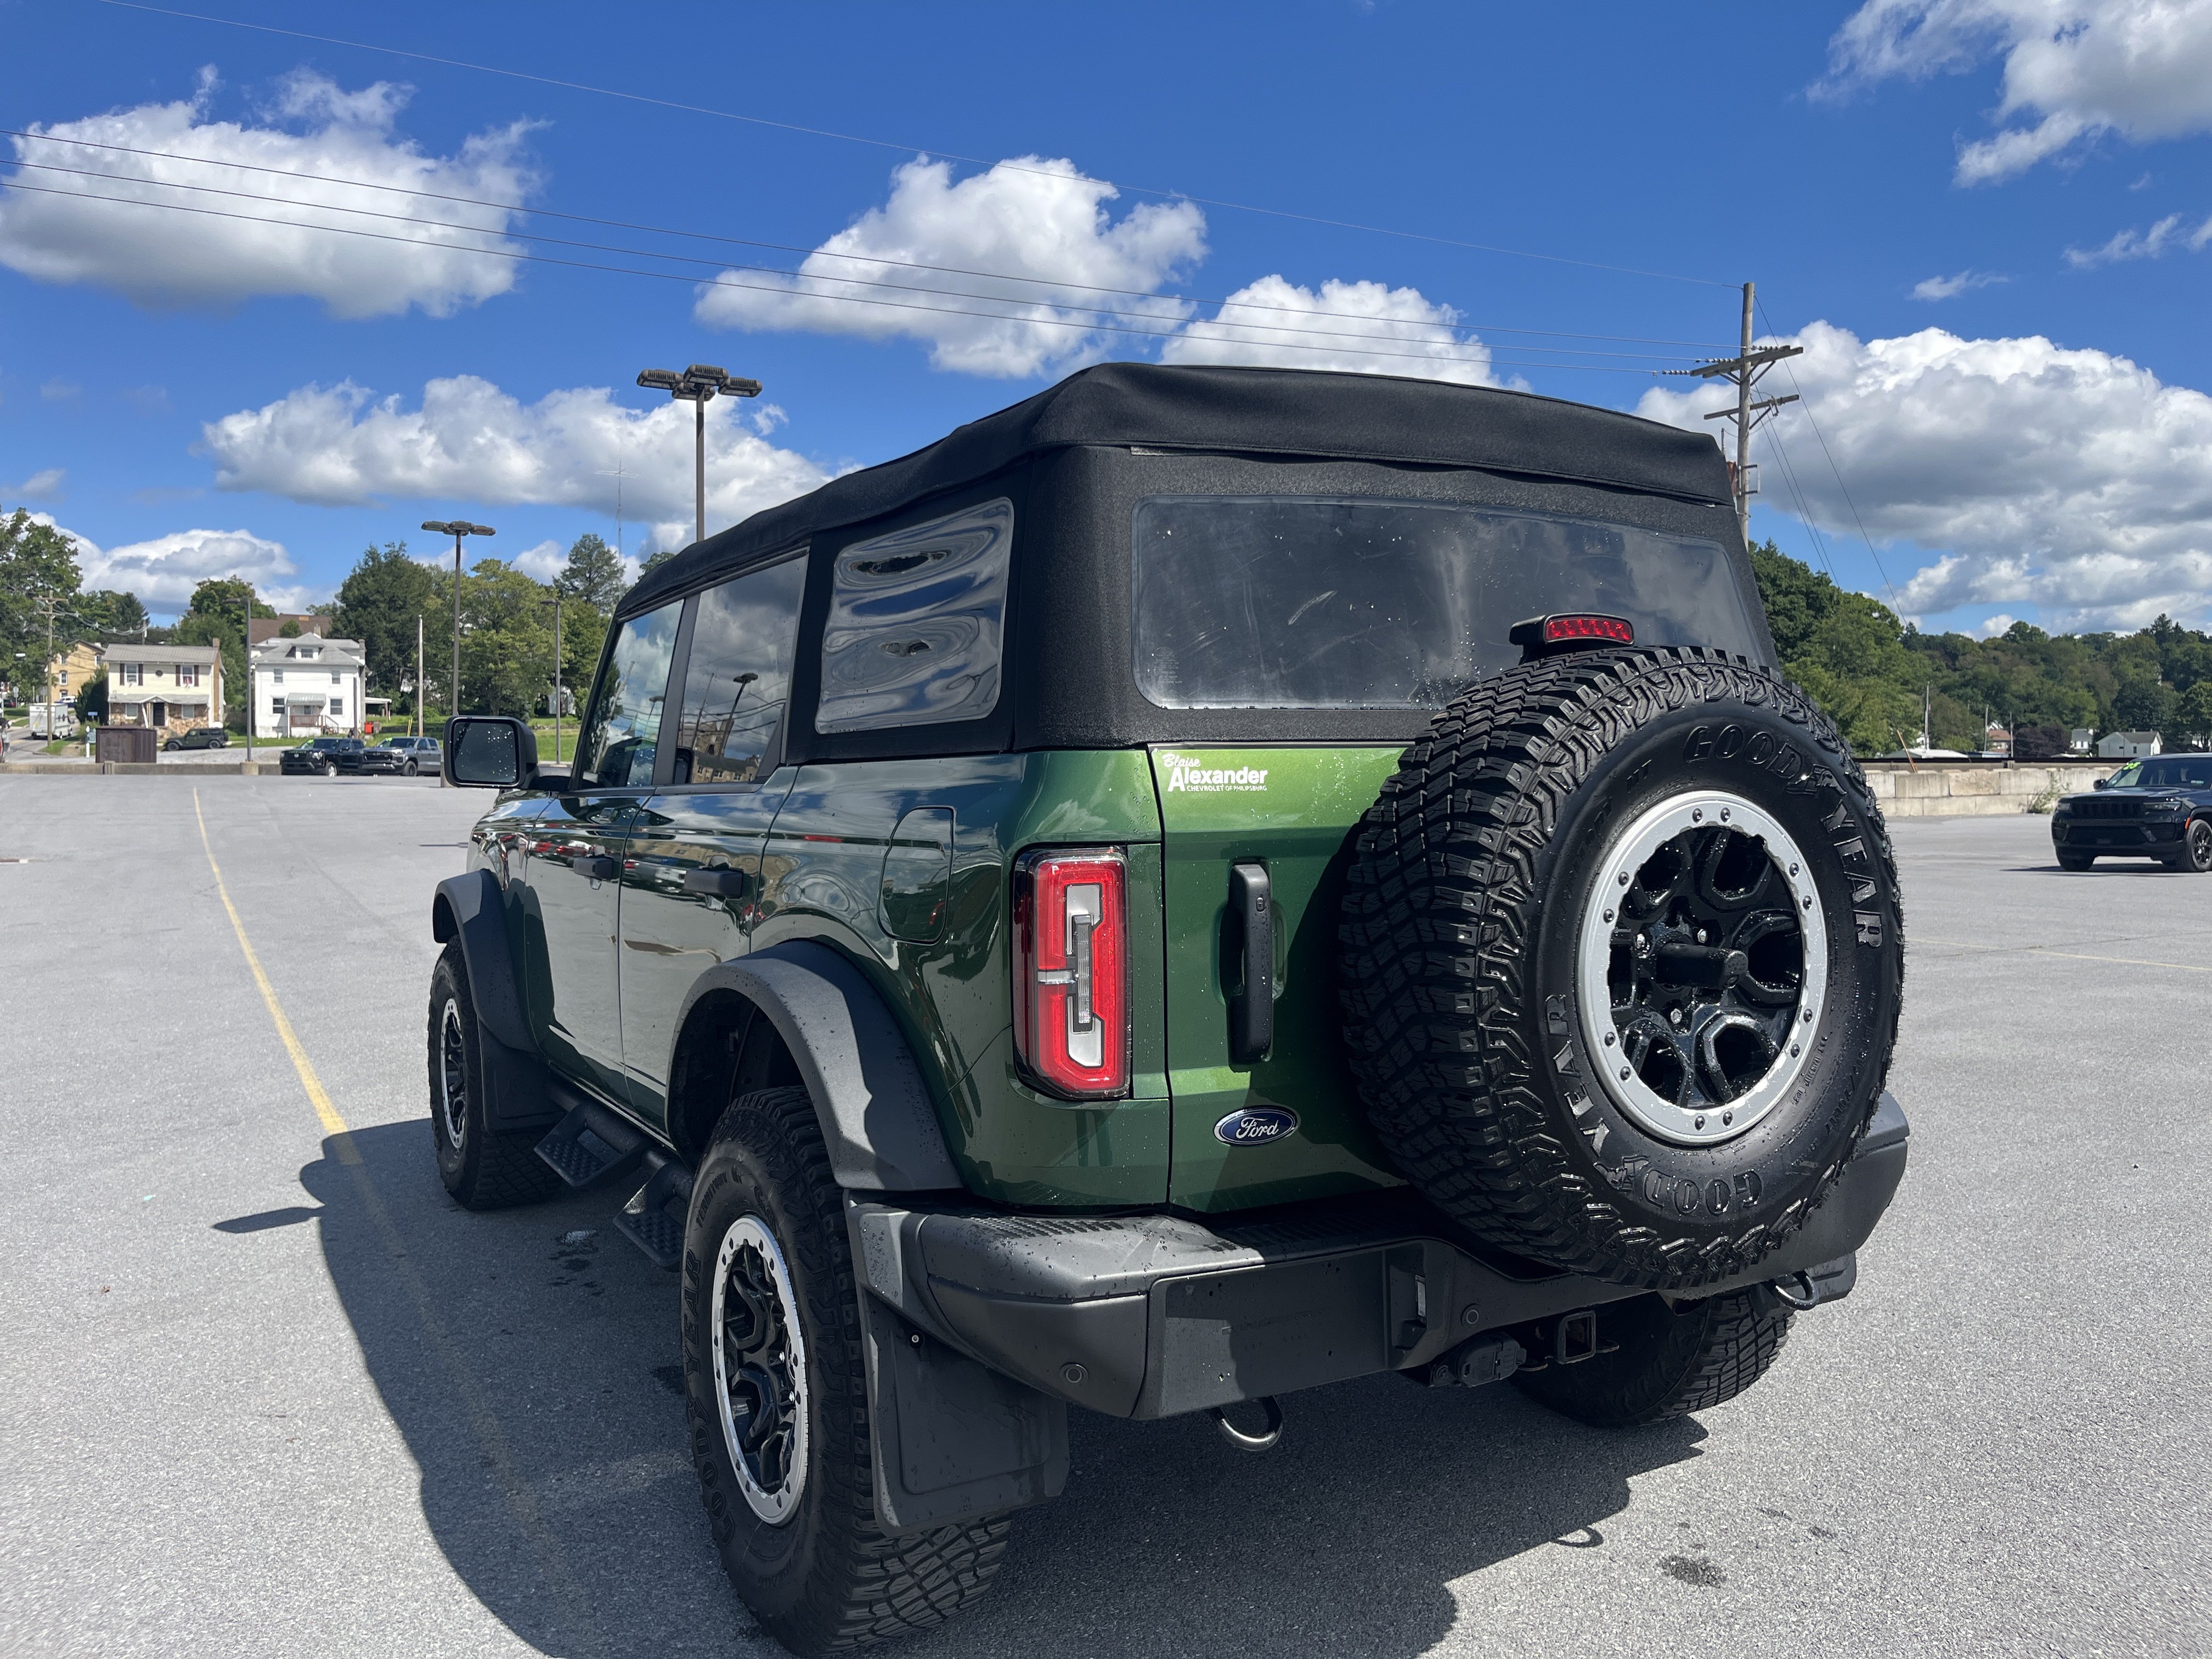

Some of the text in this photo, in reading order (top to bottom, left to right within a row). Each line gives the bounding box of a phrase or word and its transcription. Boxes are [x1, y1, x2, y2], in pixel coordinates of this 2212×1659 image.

[1162, 753, 1201, 767] Blaise
[1167, 766, 1268, 792] Alexander
[1683, 724, 1883, 947] GOODYEAR
[1235, 1117, 1279, 1139] Ford
[1545, 994, 1764, 1216] GOODYEAR
[696, 1171, 727, 1228] TERRITORY
[683, 1249, 736, 1546] GOODYEAR
